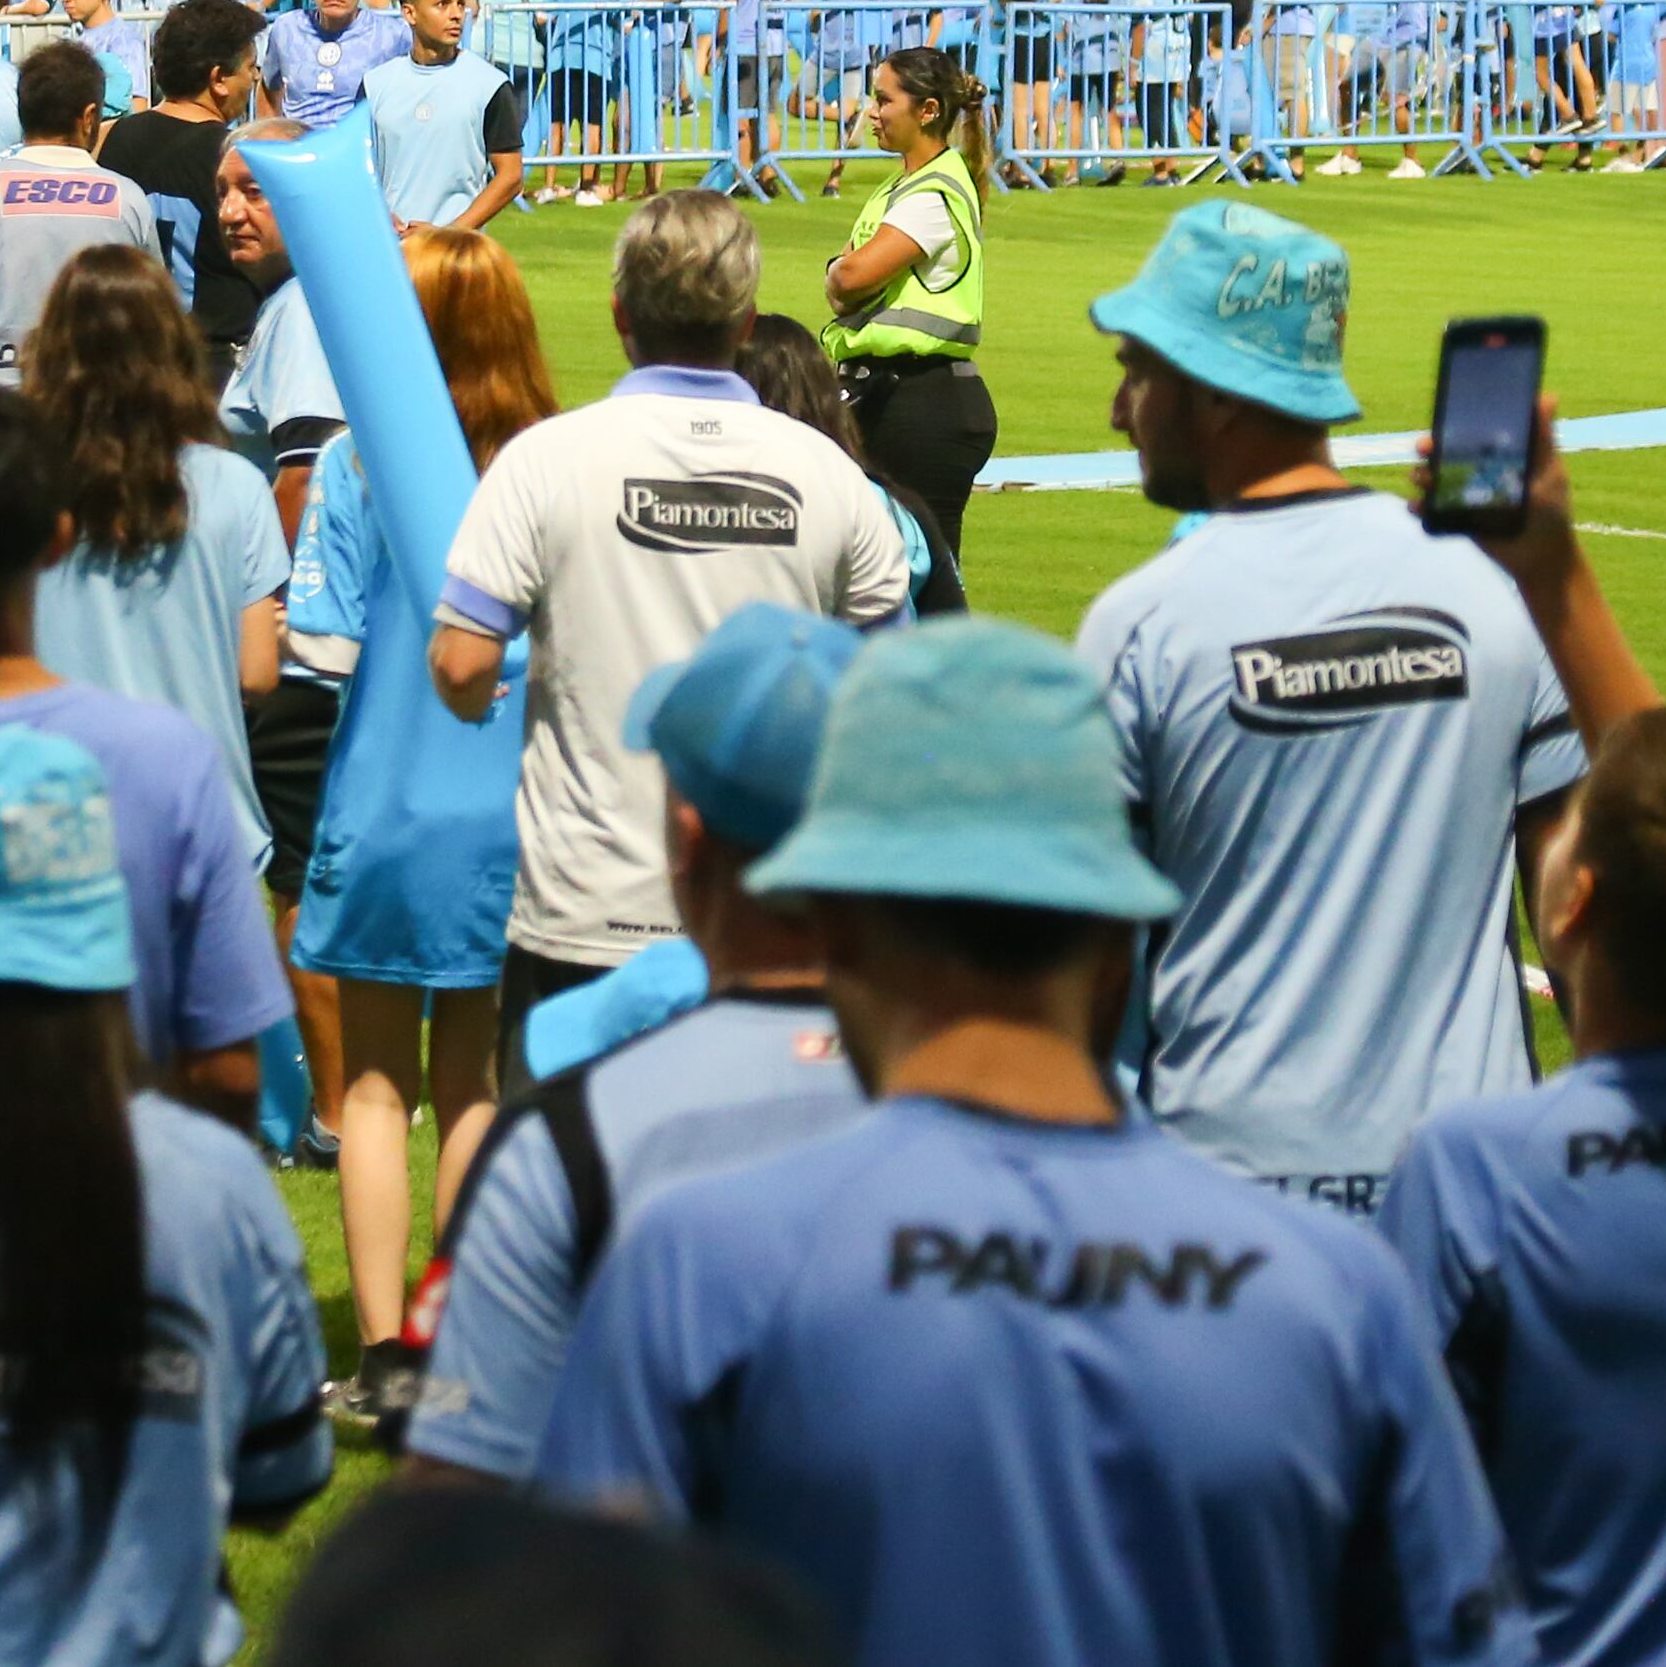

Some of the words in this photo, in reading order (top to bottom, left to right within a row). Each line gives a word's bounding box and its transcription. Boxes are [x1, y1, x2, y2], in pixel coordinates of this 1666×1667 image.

[3, 179, 118, 205] ESCO
[690, 420, 723, 436] 1905
[629, 485, 796, 531] Piamontesa
[1233, 646, 1464, 704] Piamontesa
[885, 1222, 1271, 1312] PAUNY
